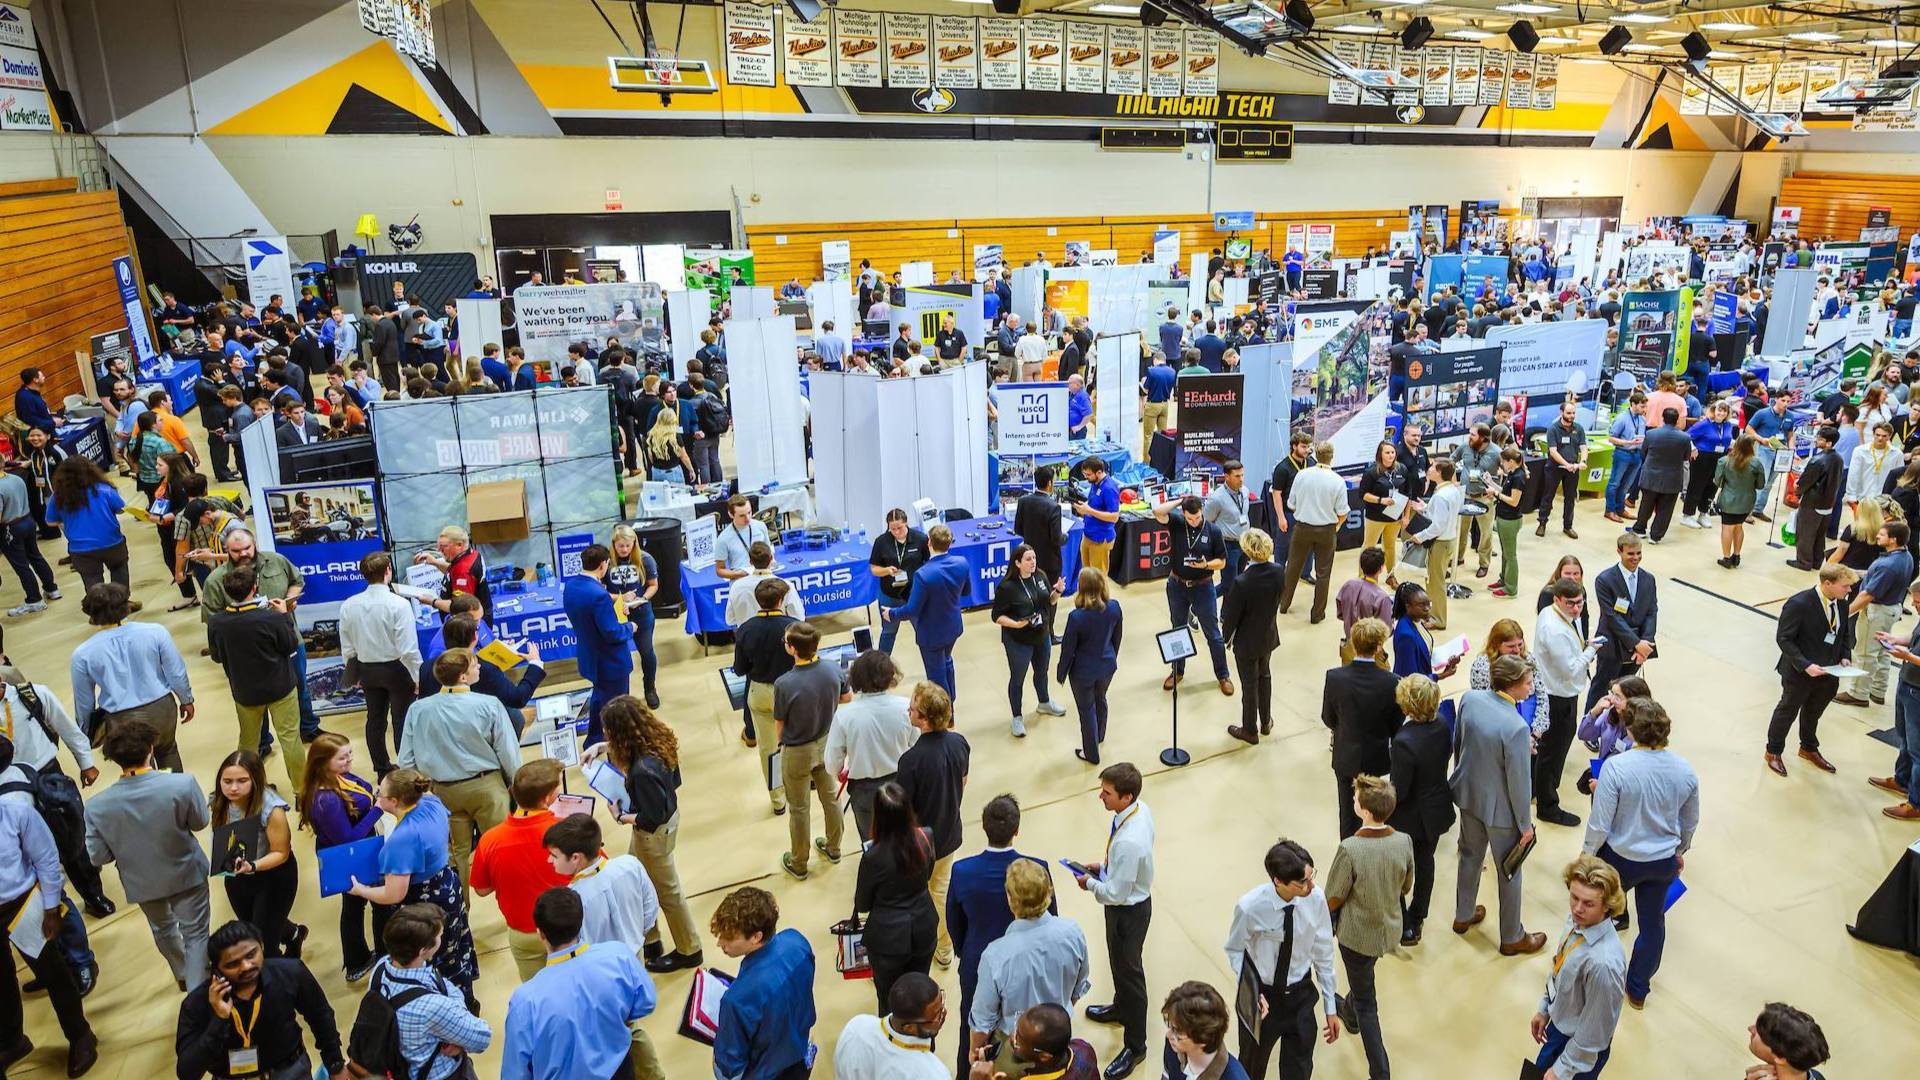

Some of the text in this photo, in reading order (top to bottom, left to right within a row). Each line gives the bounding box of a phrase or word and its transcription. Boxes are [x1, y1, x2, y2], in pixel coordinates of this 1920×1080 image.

[736, 5, 762, 13] Michigan
[729, 11, 771, 20] Technological
[845, 12, 871, 20] Michigan
[735, 19, 765, 27] University
[839, 18, 878, 26] Technological
[844, 27, 872, 36] University
[1111, 33, 1142, 41] Technological
[729, 32, 771, 50] Huskies
[1150, 36, 1180, 44] Technological
[788, 38, 826, 56] Huskies
[840, 39, 877, 58] Huskies
[890, 42, 926, 59] Huskies
[984, 40, 1017, 58] Huskies
[1028, 44, 1059, 60] Huskies
[1070, 45, 1101, 61] Huskies
[939, 45, 973, 63] Huskies
[1111, 51, 1141, 67] Huskies
[1151, 52, 1179, 69] Huskies
[1188, 57, 1216, 73] Huskies
[3, 59, 38, 77] Domino's
[1226, 95, 1276, 118] TECH
[6, 108, 51, 125] MarketPlace
[365, 263, 418, 274] KOHLER
[519, 288, 586, 297] barrywehmiller
[523, 306, 584, 316] We've been
[524, 317, 564, 326] waiting
[1315, 318, 1339, 328] SME
[1646, 337, 1661, 345] 200+
[1564, 359, 1588, 367] CAREER.
[1191, 390, 1236, 402] Erhardt
[813, 588, 852, 605] Outside
